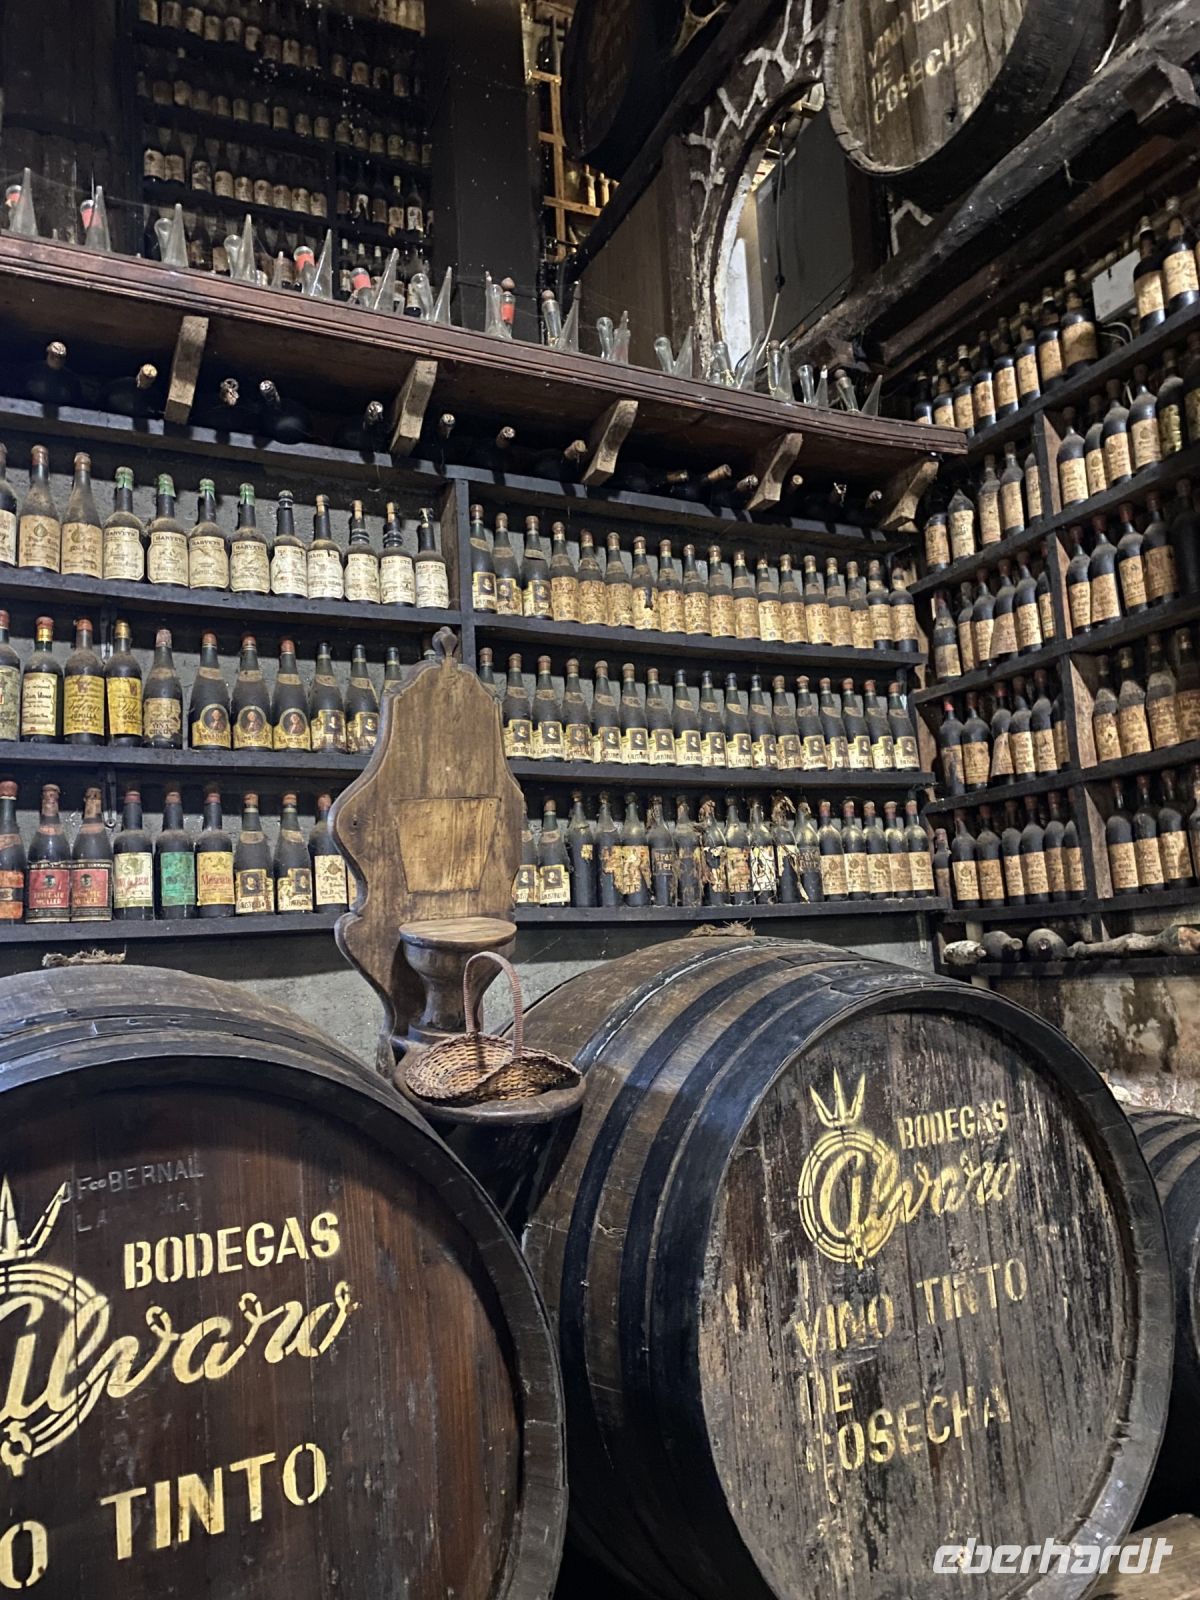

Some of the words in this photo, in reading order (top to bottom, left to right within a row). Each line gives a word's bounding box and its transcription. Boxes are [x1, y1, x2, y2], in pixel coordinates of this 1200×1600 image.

[898, 1100, 1009, 1151] BODEGAS
[124, 1212, 341, 1290] BODEGAS
[916, 1257, 1028, 1325] TINTO
[795, 1294, 894, 1358] VINO
[100, 1442, 328, 1561] TINTO
